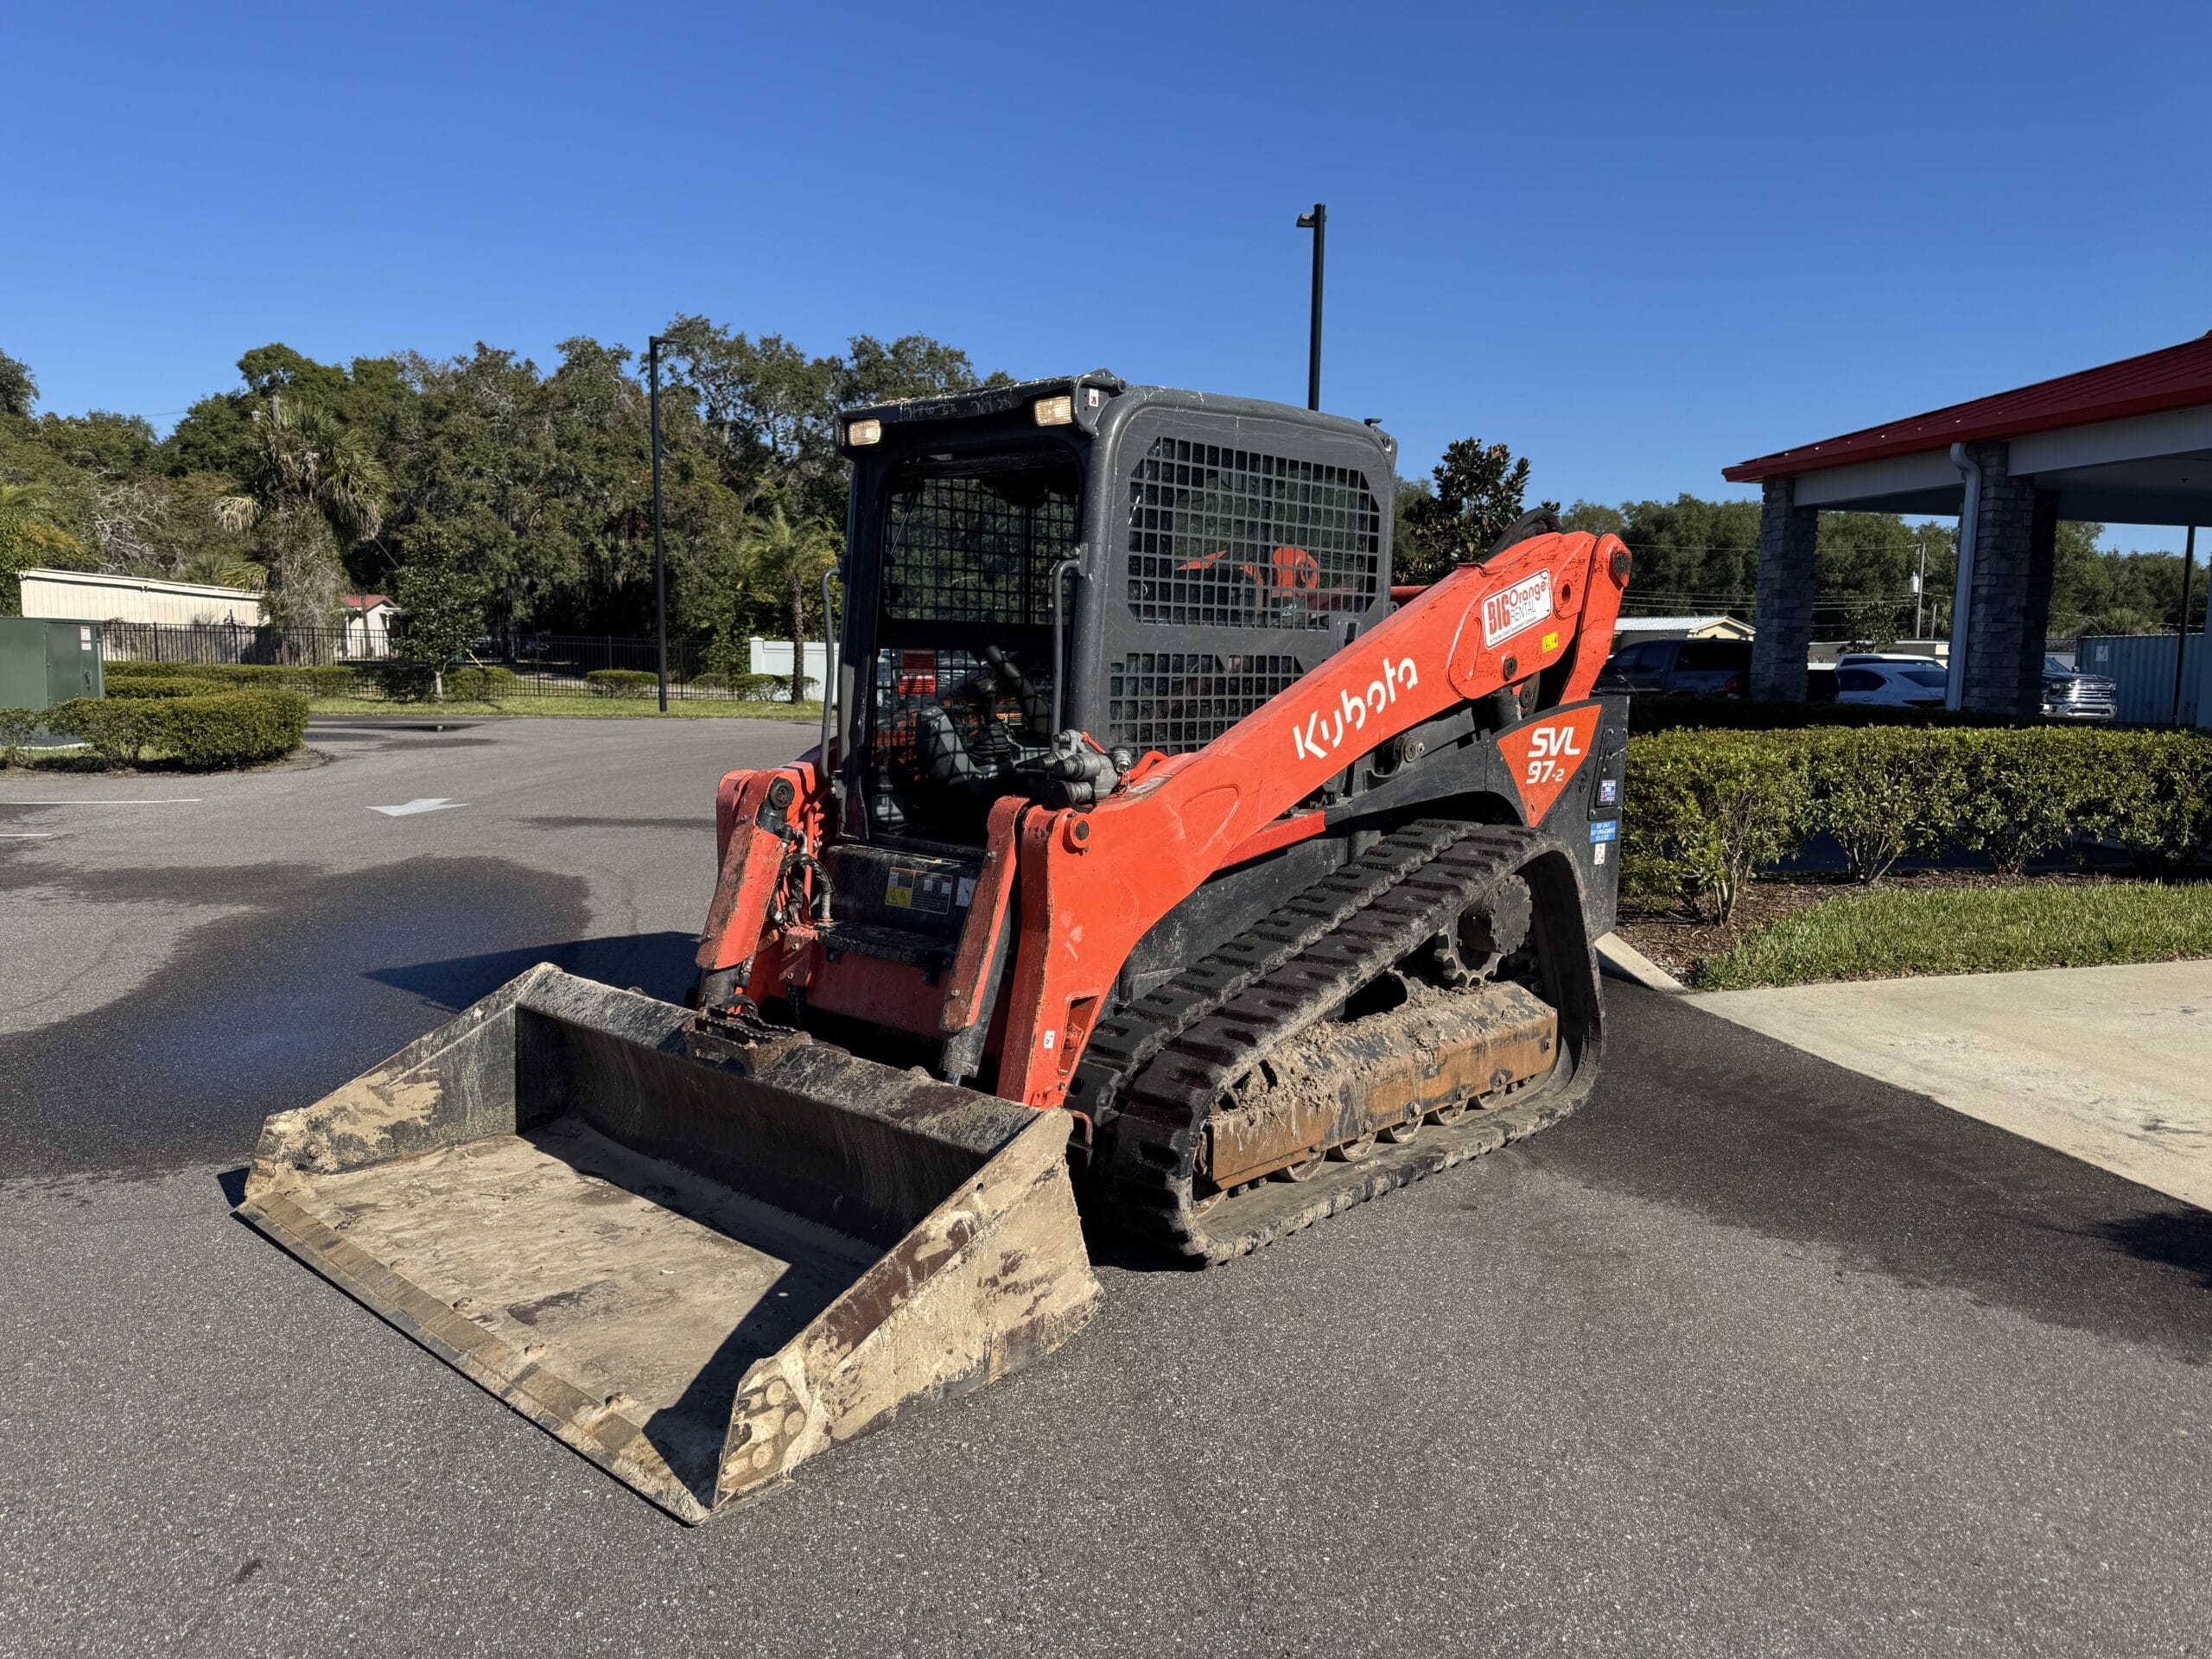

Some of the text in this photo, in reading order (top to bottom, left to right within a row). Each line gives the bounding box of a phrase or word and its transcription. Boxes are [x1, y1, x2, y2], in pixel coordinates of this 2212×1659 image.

[1487, 594, 1510, 635] BIG
[1510, 581, 1547, 607] Orange
[1510, 600, 1536, 622] RENTAL
[1293, 657, 1419, 761] Kubota
[1527, 726, 1581, 758] SVL
[1525, 760, 1565, 785] 97-2
